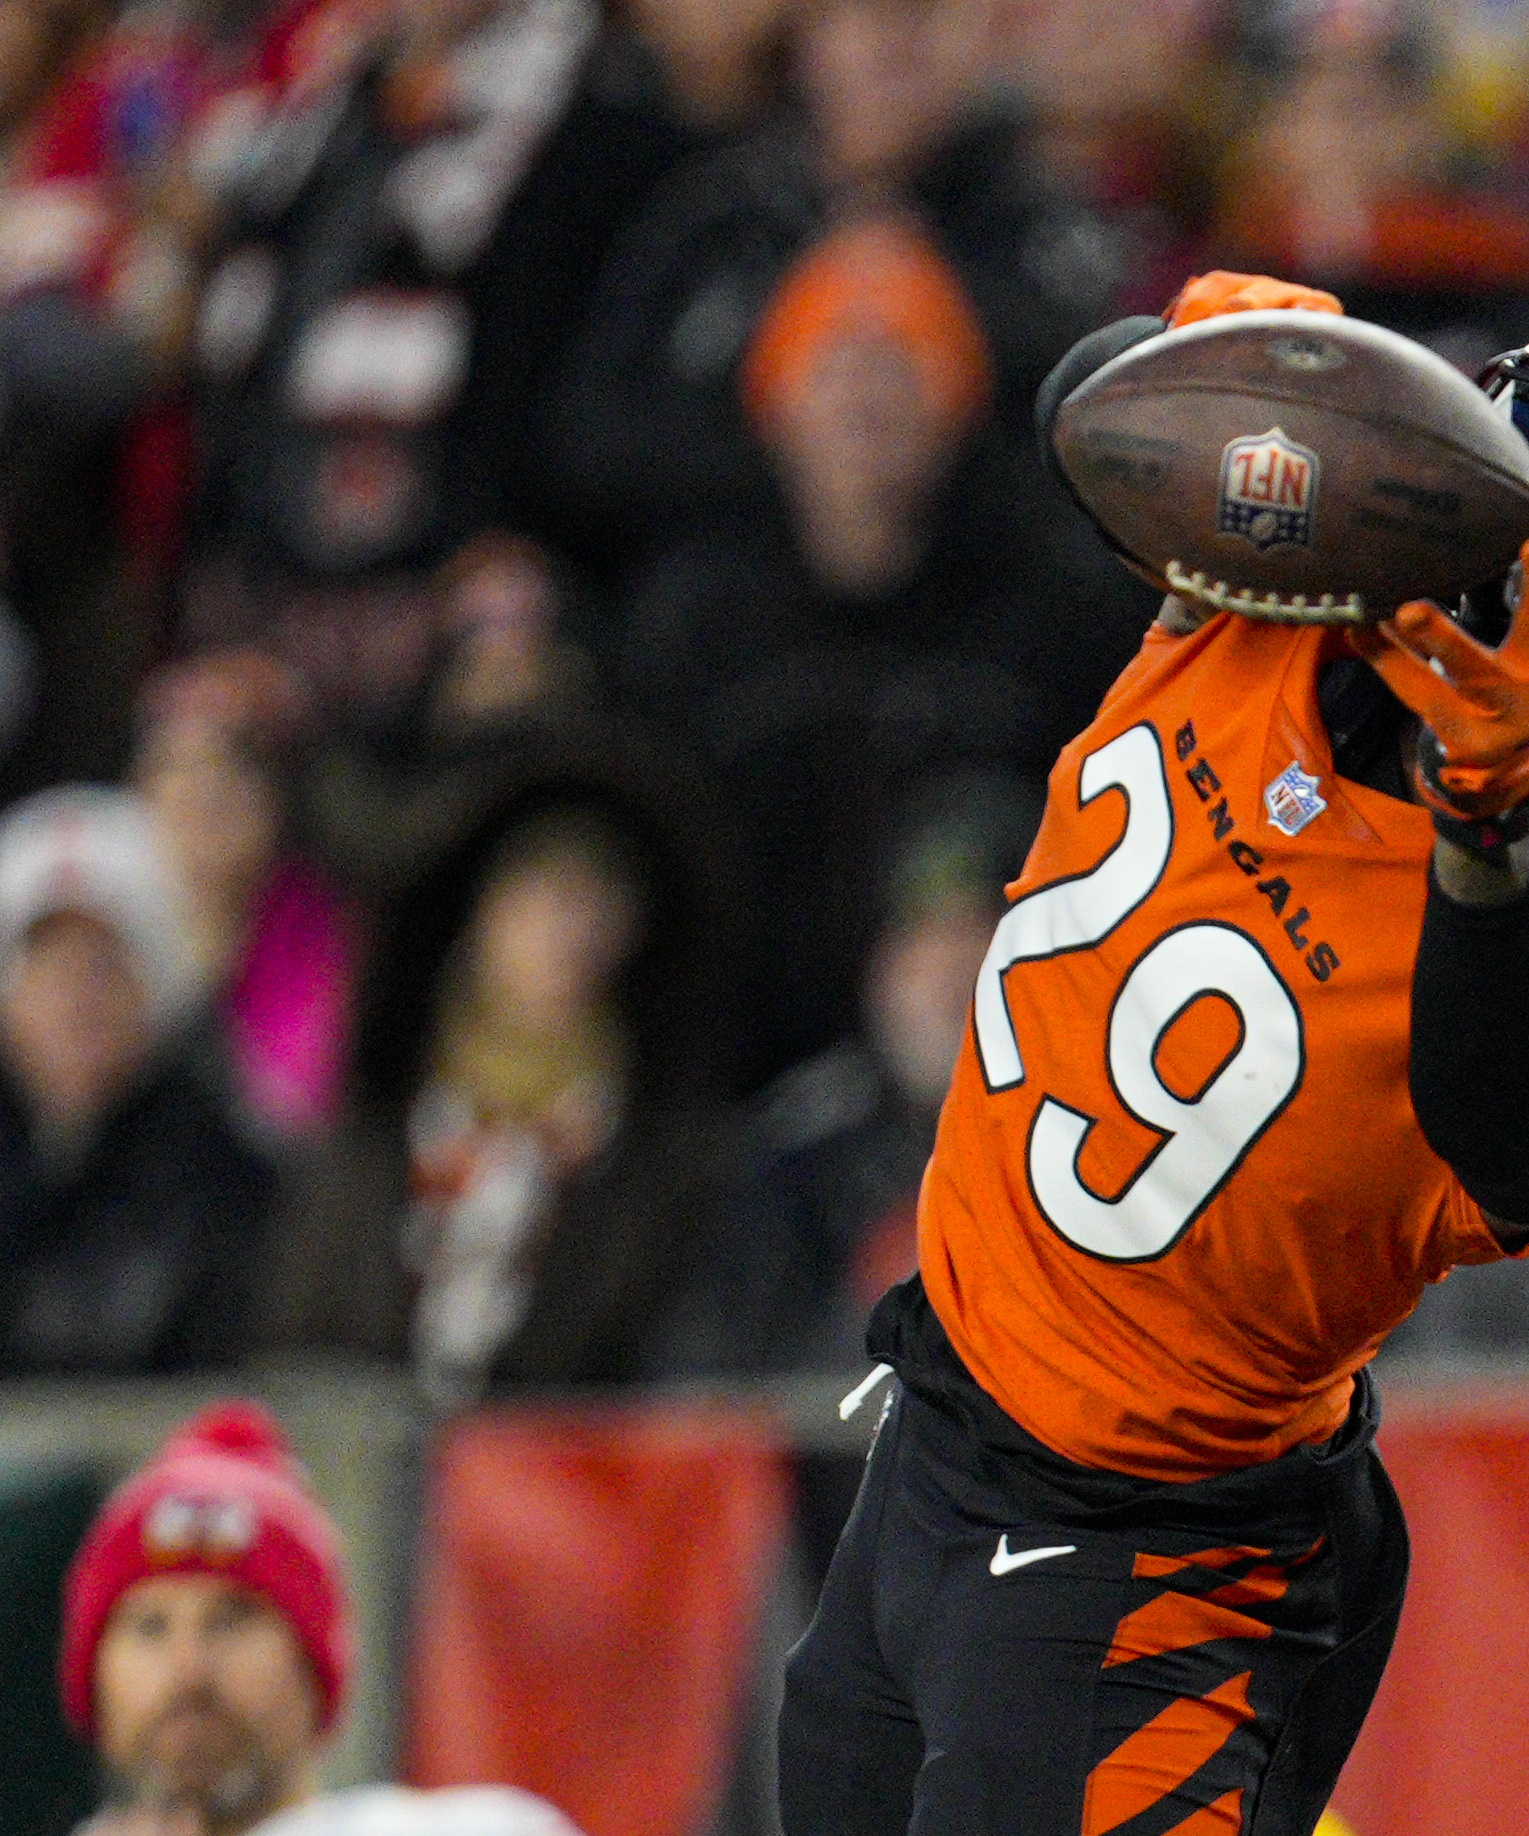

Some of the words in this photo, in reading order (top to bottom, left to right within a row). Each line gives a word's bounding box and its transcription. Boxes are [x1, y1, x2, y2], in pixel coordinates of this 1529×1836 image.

[1231, 448, 1311, 508] NFL
[1174, 718, 1341, 984] BENGALS
[973, 719, 1306, 1265] 29
